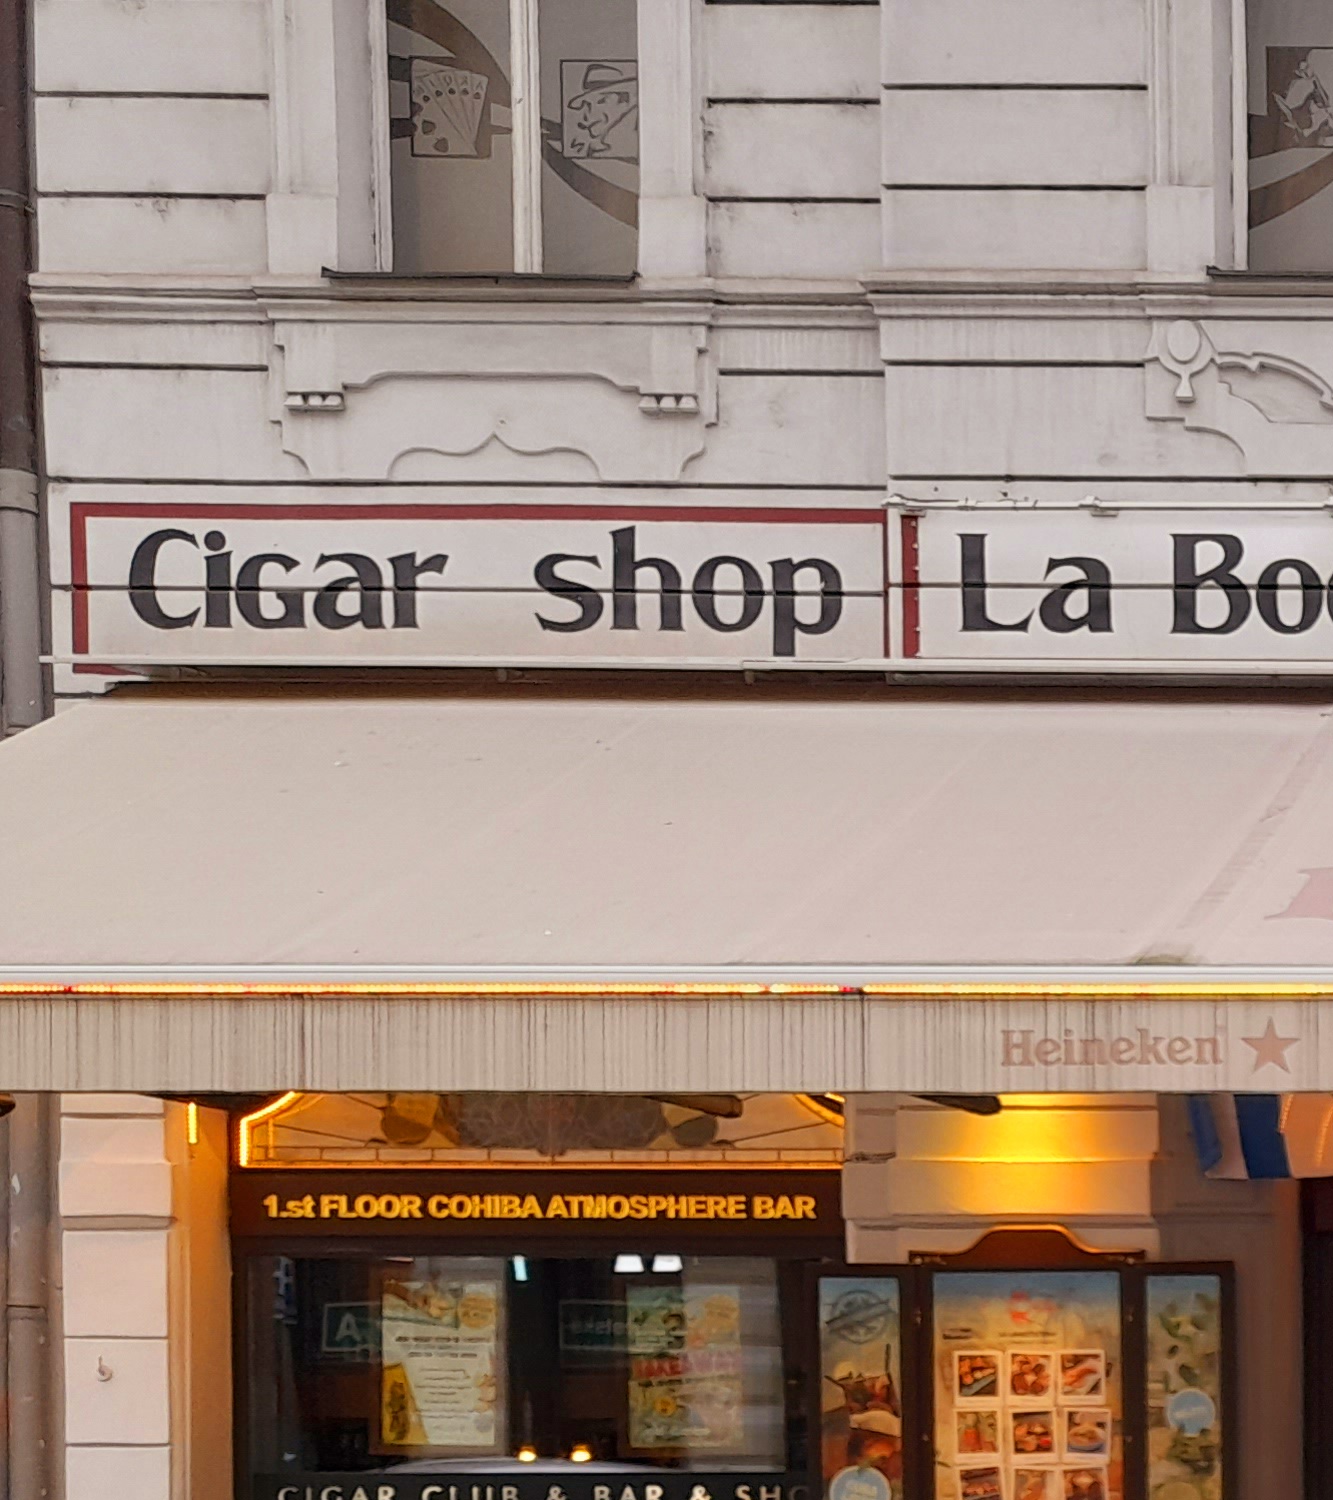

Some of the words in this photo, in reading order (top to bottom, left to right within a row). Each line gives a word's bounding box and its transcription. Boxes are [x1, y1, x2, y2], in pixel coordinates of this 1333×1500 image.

[128, 528, 449, 630] Cigar
[533, 525, 843, 658] shop
[957, 531, 1116, 635] La
[1000, 1027, 1224, 1067] Heineken
[320, 1195, 423, 1219] FLOOR
[428, 1195, 543, 1219] COHIBA
[545, 1195, 748, 1219] ATMOSPHERE
[753, 1195, 817, 1219] BAR
